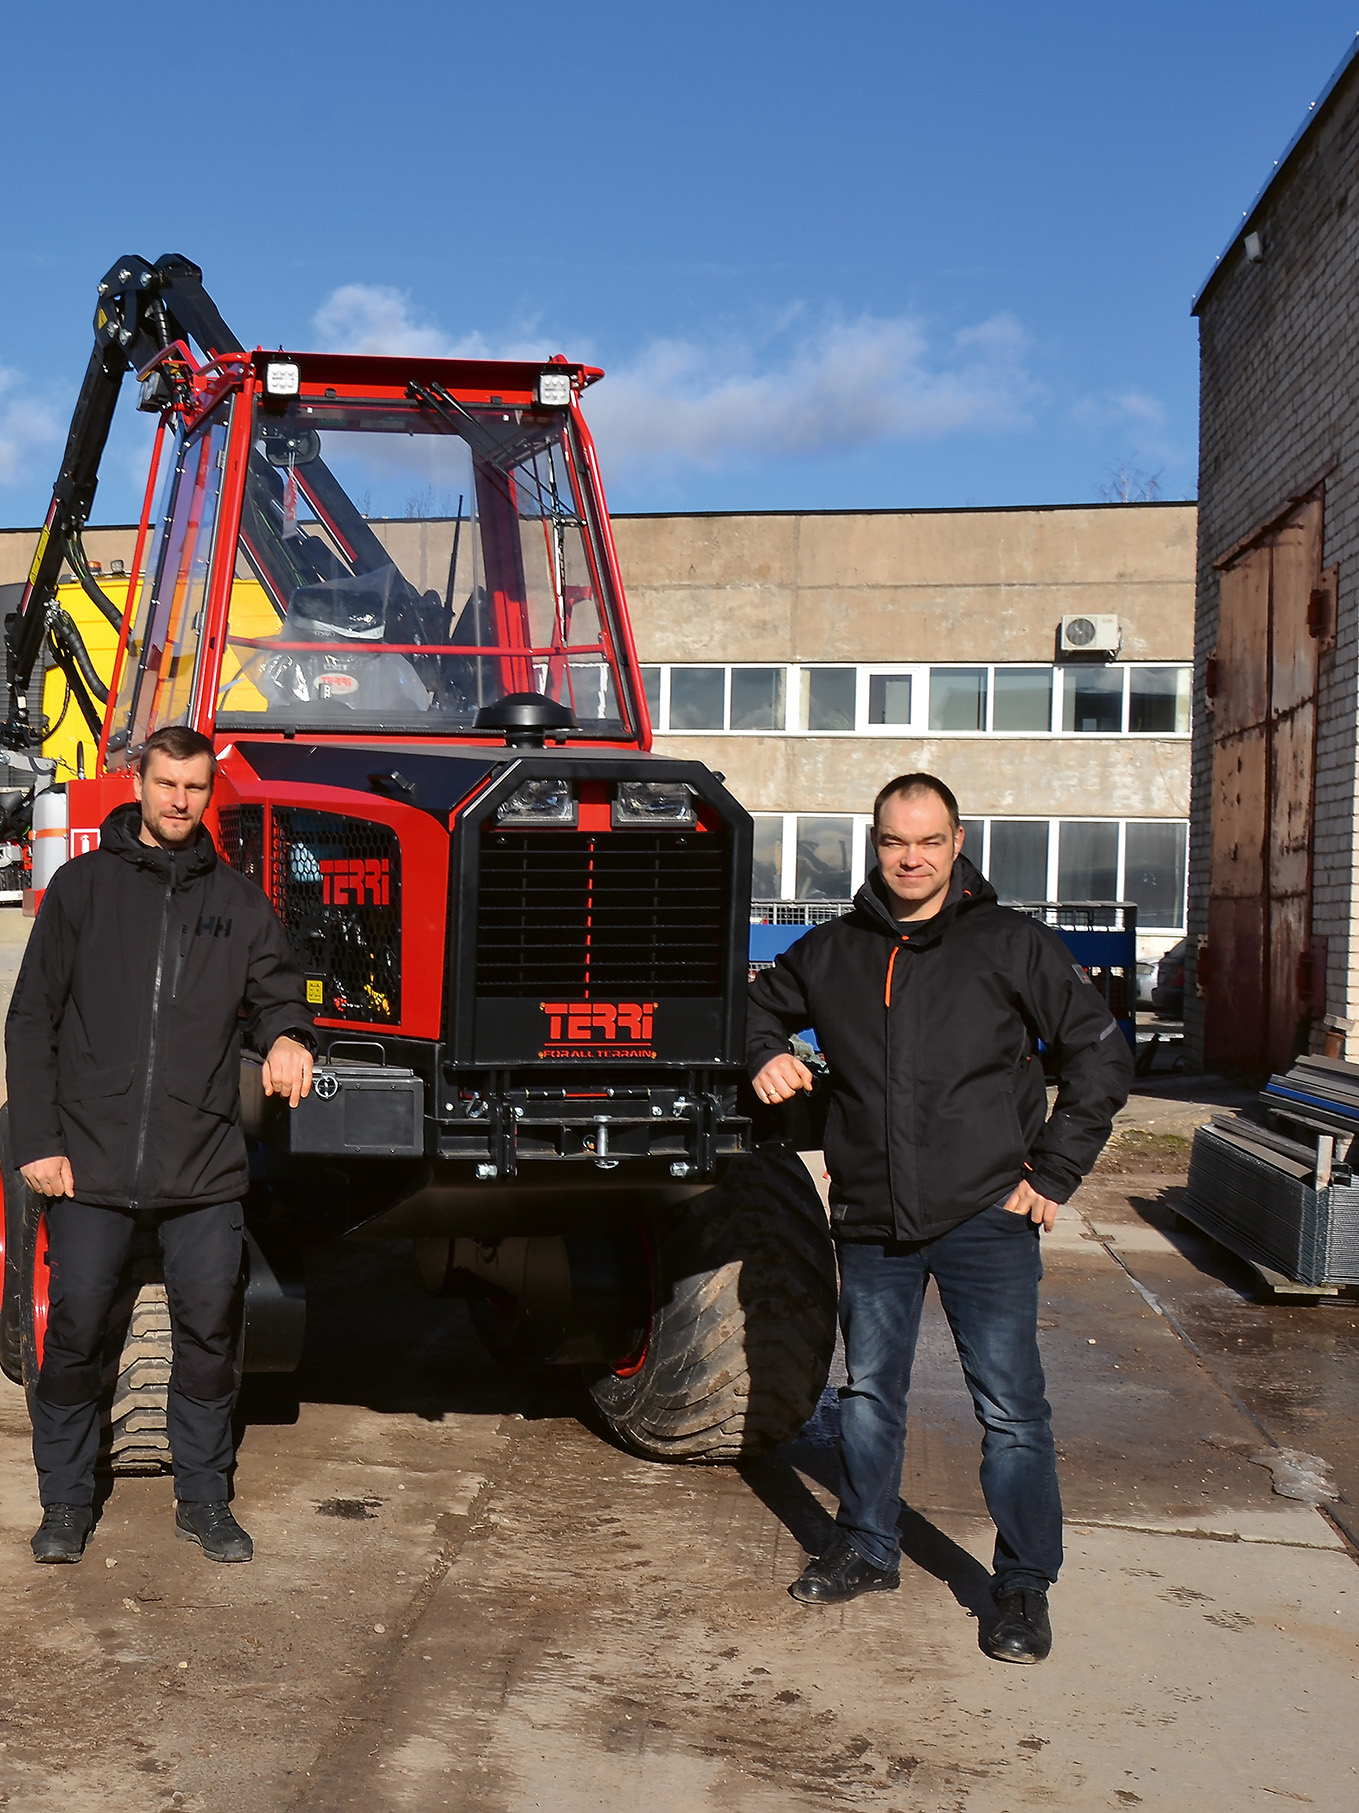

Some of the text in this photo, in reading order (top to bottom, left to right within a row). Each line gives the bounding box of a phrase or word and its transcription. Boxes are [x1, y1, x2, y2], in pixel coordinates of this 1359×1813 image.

[543, 1050, 652, 1058] FOR ALL TERRAIN
